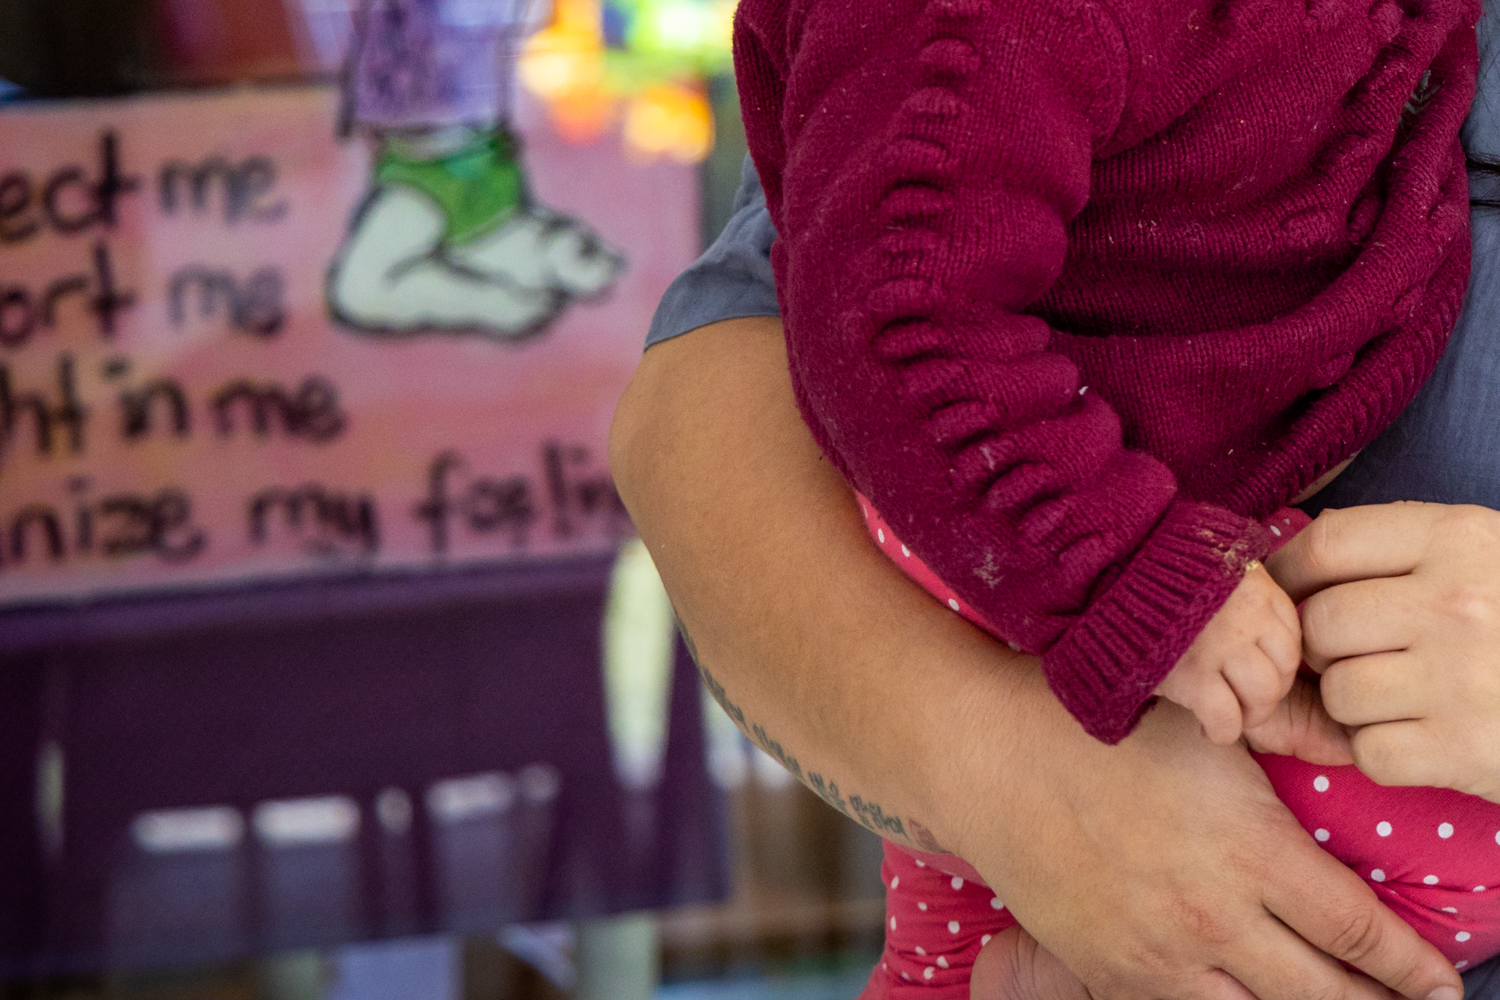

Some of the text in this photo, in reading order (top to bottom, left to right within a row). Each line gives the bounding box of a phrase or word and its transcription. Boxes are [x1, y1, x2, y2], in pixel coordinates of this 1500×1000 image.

[158, 152, 290, 227] me
[167, 264, 288, 340] me
[210, 376, 348, 444] me
